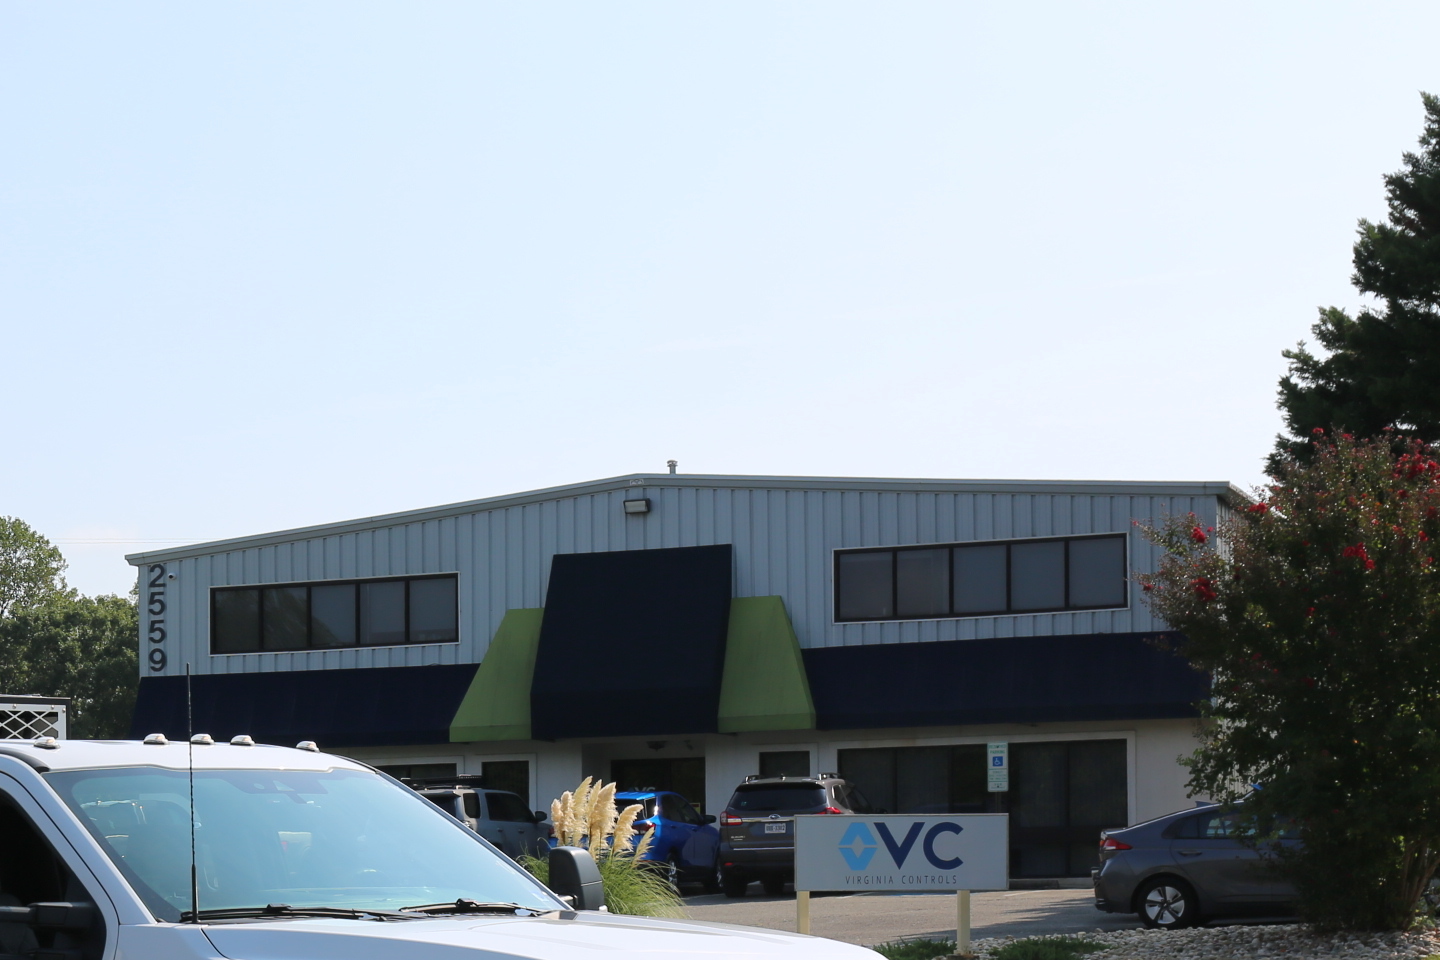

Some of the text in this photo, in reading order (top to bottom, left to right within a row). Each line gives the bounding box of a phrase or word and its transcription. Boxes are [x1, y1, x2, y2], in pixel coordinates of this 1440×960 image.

[148, 563, 167, 673] 2559
[873, 821, 964, 871] VC
[845, 874, 958, 885] VIRGINIA CONTROLS
